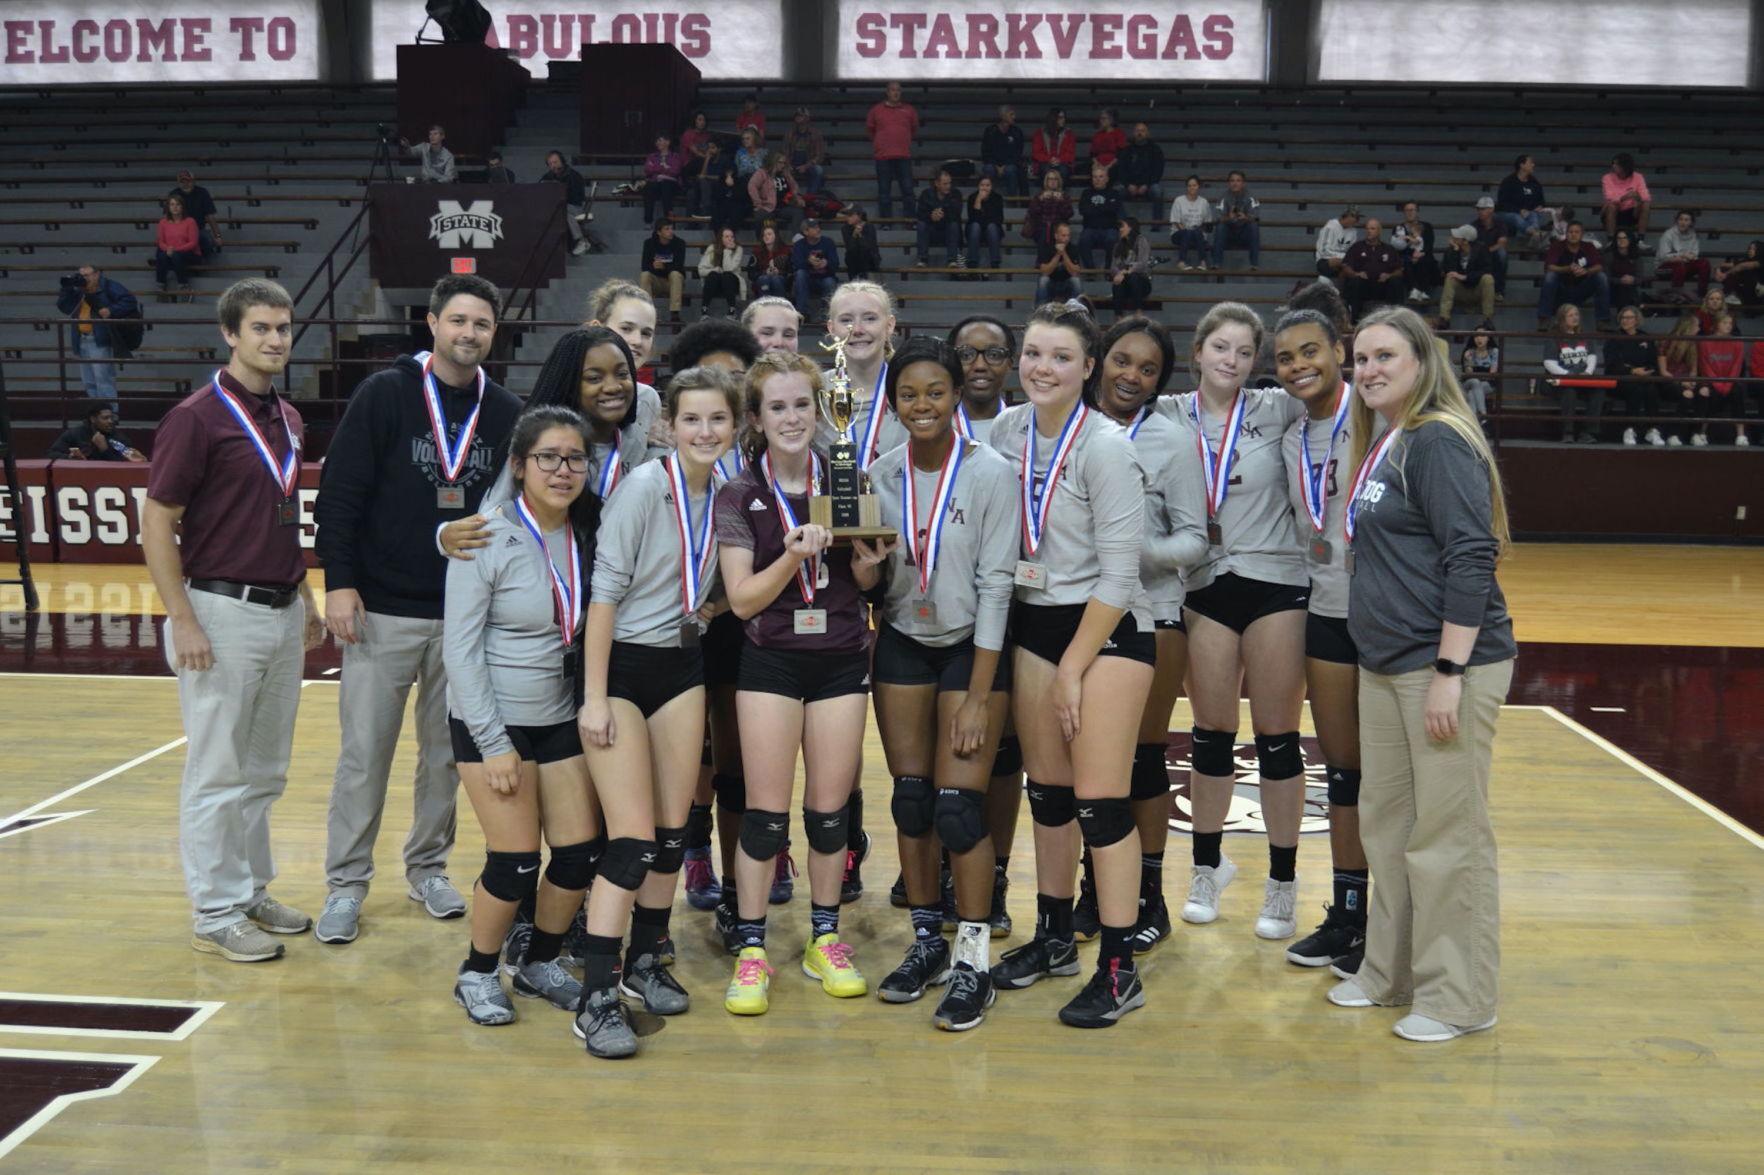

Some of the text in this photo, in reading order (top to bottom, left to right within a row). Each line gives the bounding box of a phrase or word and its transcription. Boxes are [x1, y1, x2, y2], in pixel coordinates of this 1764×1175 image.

[230, 16, 297, 61] TO
[484, 13, 711, 59] BULOUS
[855, 12, 1234, 60] STARKVEGAS
[443, 215, 489, 231] STATE
